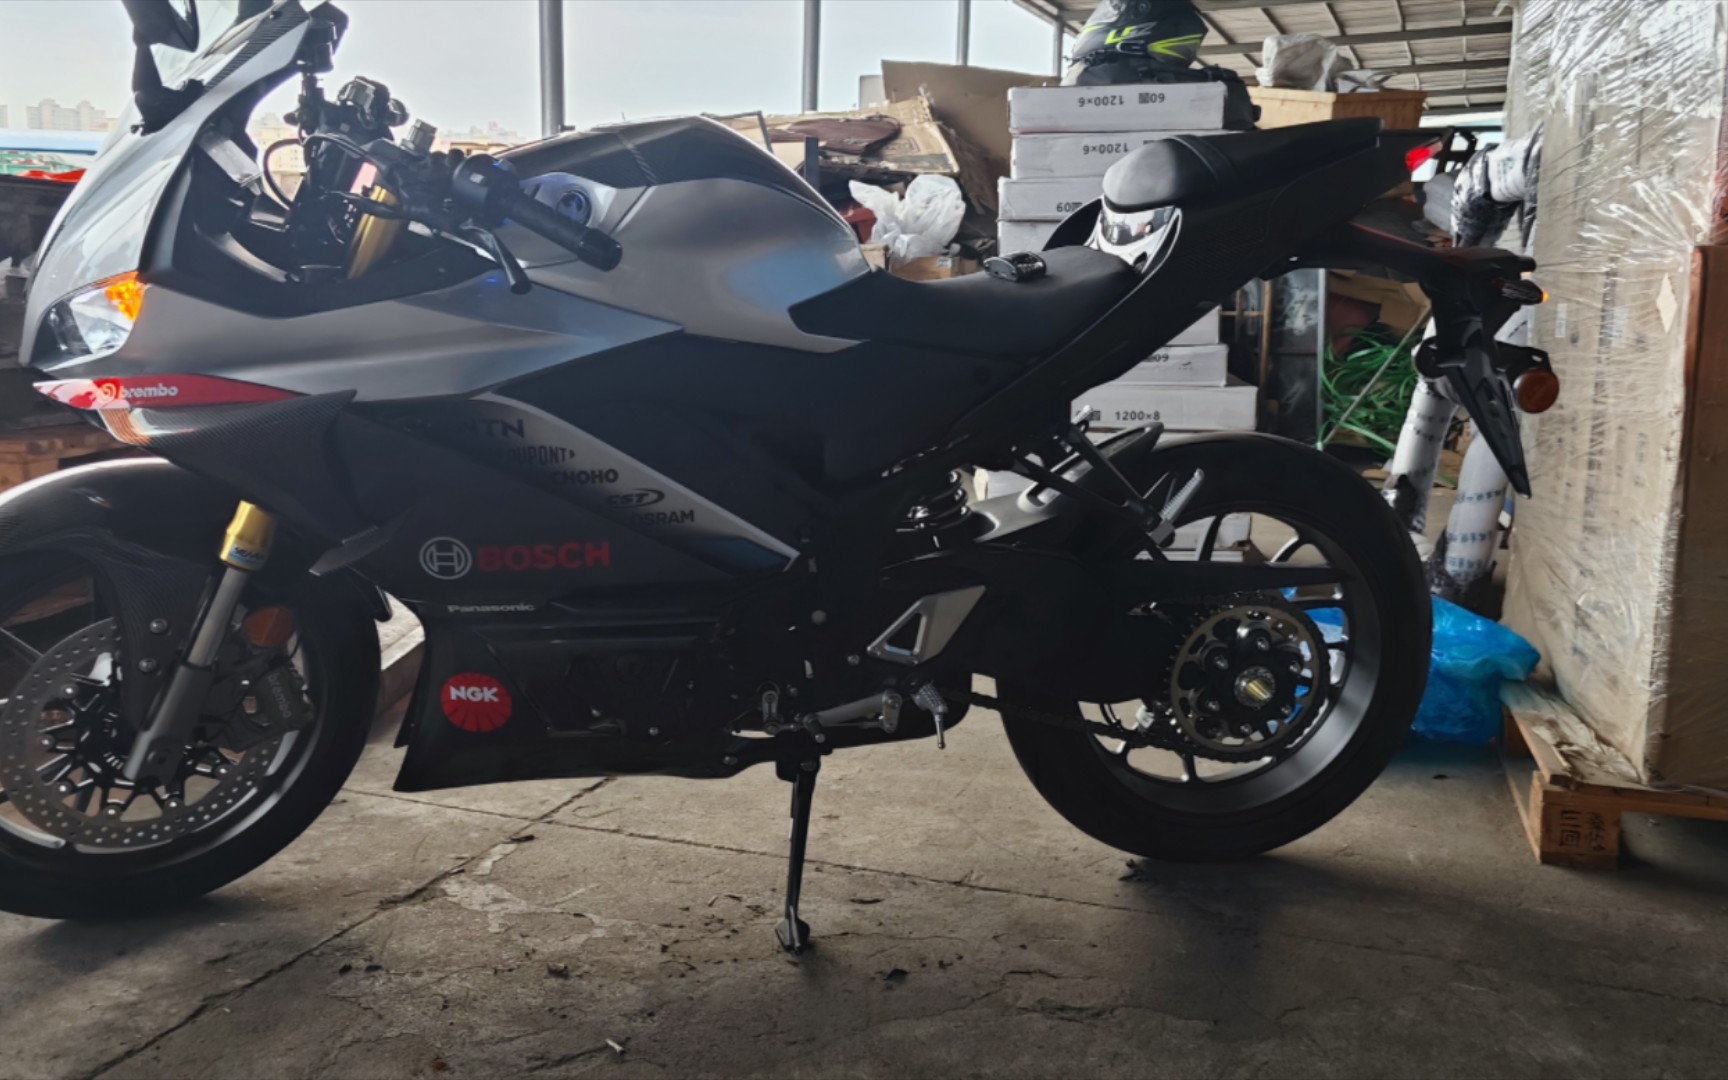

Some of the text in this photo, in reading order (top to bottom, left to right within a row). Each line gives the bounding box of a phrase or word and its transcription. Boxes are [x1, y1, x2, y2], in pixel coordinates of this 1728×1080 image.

[119, 383, 179, 400] brembo
[551, 468, 620, 486] CHOHO
[630, 508, 695, 526] OSRAM
[476, 541, 612, 573] BOSCH
[446, 601, 536, 614] Panasonic
[266, 671, 293, 719] brembo
[448, 685, 500, 703] NGK
